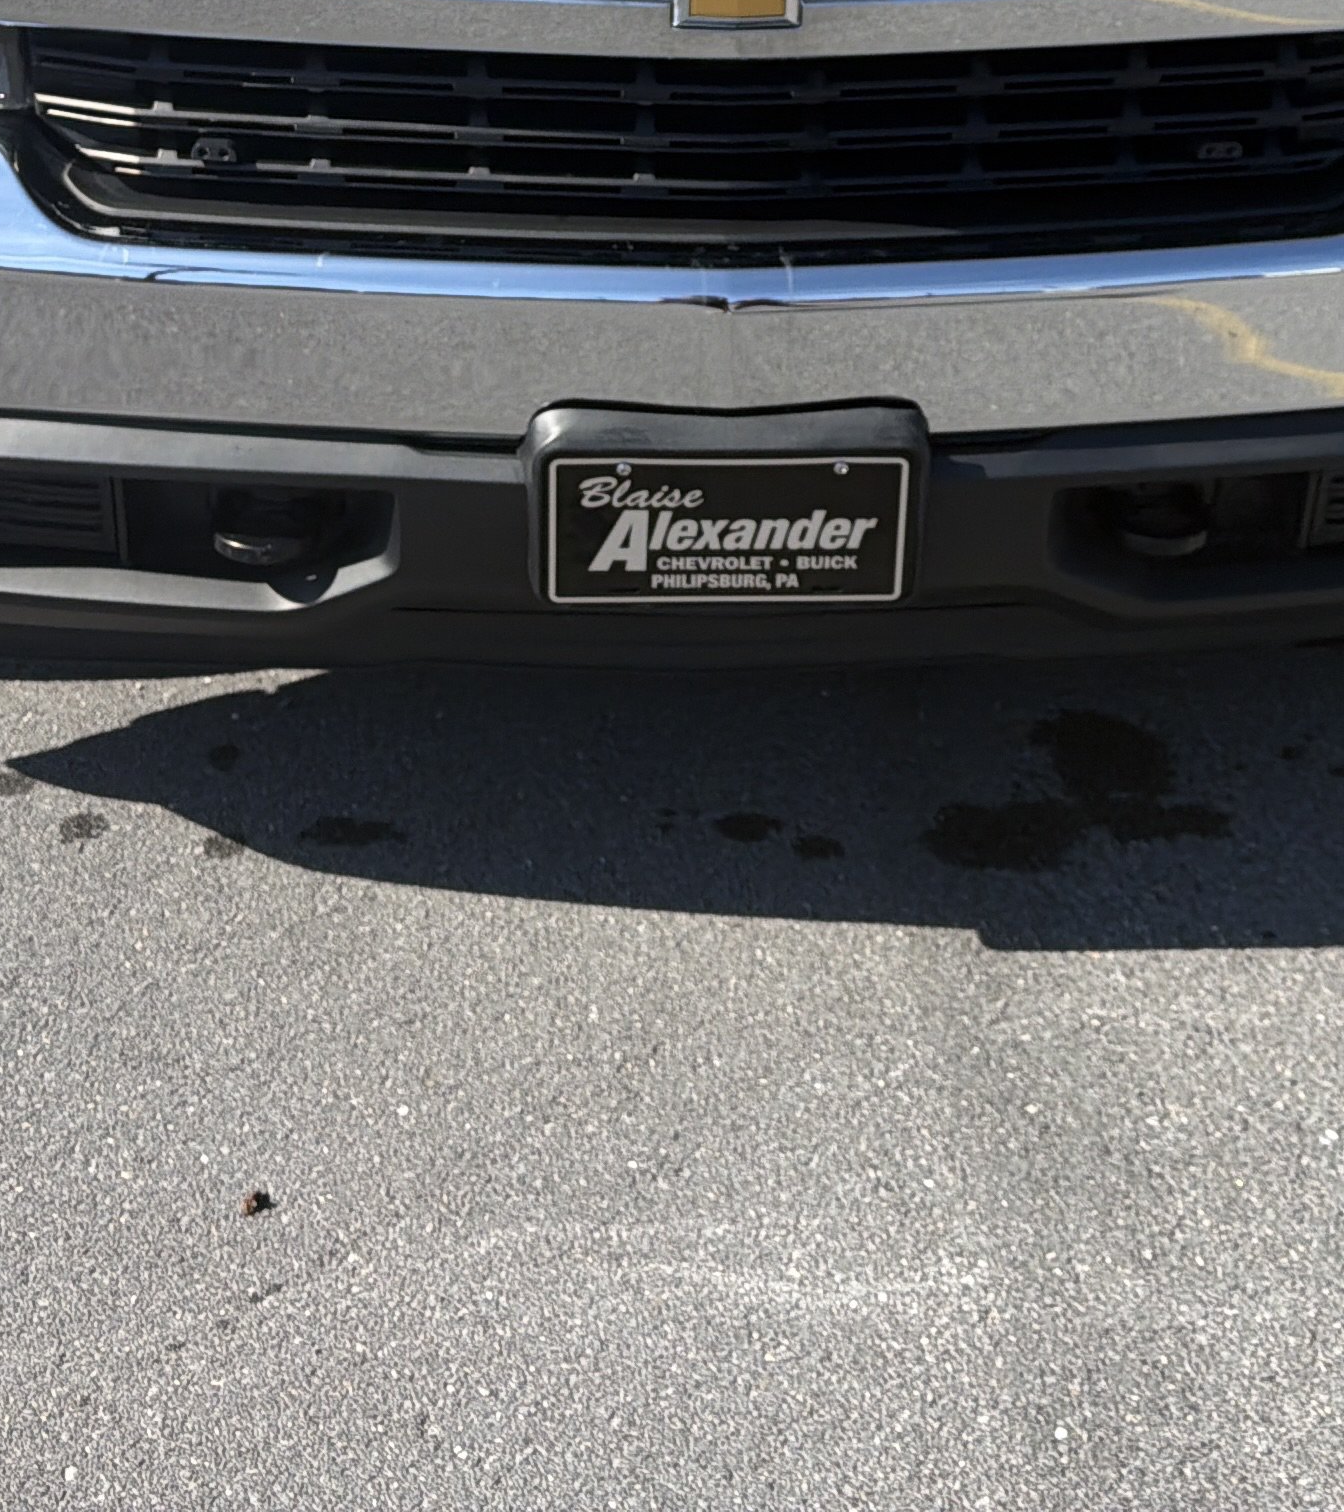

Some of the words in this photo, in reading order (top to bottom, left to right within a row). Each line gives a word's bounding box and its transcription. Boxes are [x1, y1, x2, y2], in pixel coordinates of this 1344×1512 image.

[578, 475, 705, 509] Blaise
[587, 509, 880, 573] Alexander
[656, 555, 774, 571] CHEVROLET
[795, 554, 859, 570] BUICK
[651, 573, 772, 591] PHILIPSBURG,
[774, 572, 801, 589] PA
